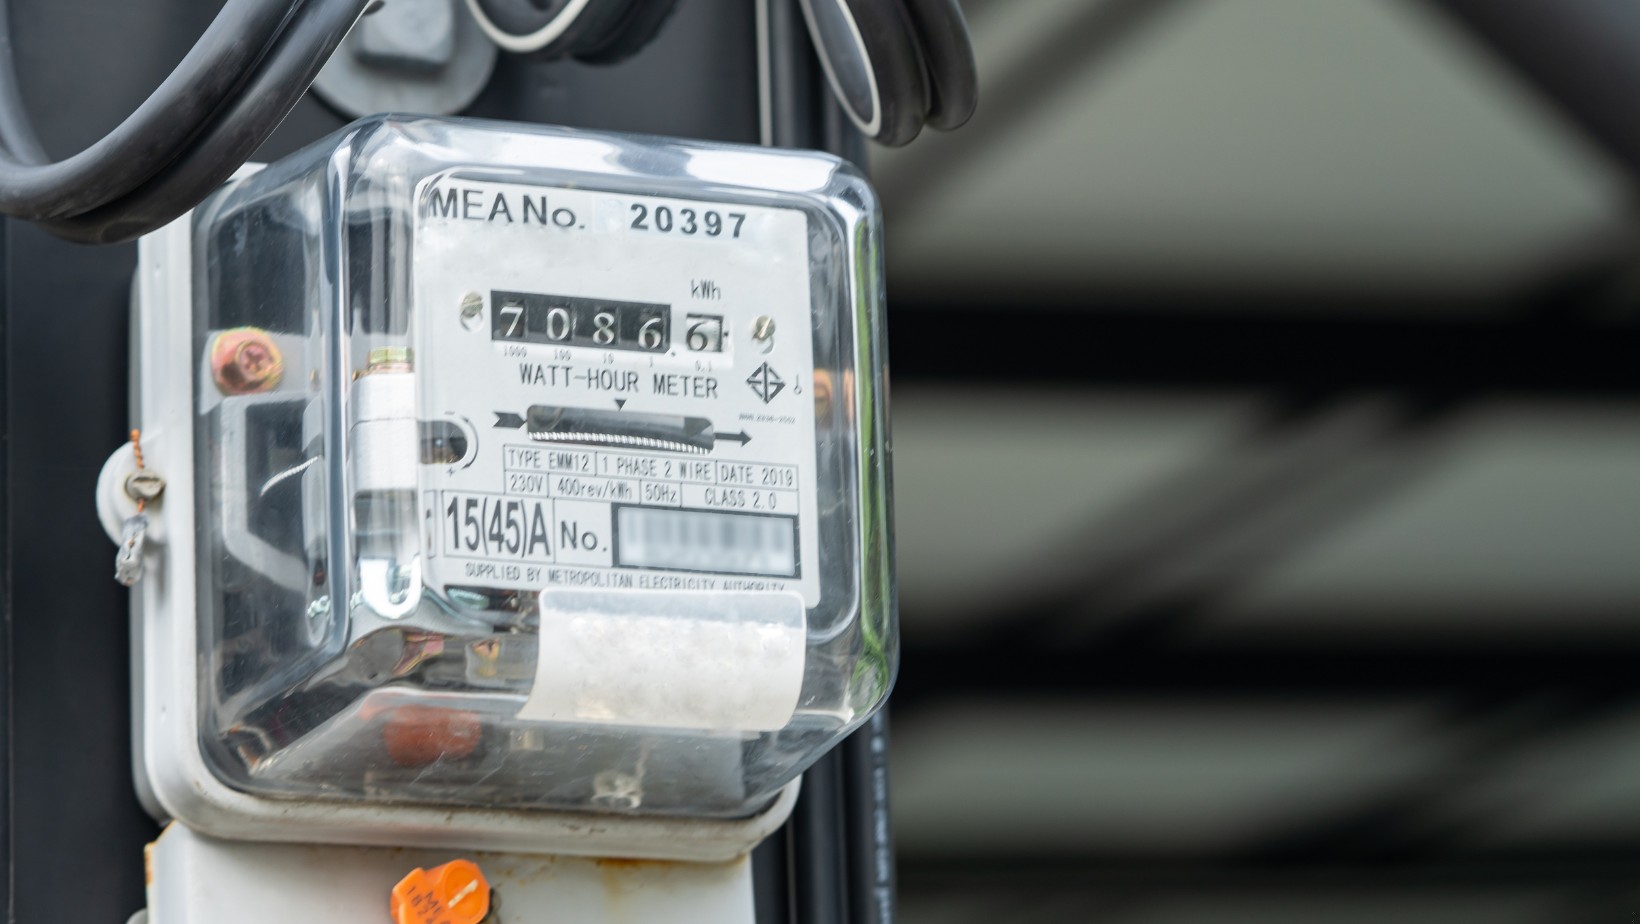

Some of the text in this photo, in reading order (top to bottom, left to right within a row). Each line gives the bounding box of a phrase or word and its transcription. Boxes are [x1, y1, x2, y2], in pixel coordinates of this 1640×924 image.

[429, 187, 747, 239] MEA No. 20397
[690, 279, 722, 300] kWh
[503, 346, 528, 359] 1000
[553, 348, 572, 362] 100
[603, 352, 615, 365] 10
[519, 363, 719, 399] WATT-HOUR METER
[508, 449, 590, 472] TYPE EMM12
[602, 456, 712, 481] 1 PHASE 2 WIRE
[510, 474, 543, 493] 230V
[720, 464, 793, 487] DATE 2019
[557, 476, 633, 500] 400rev/kWh
[645, 483, 677, 504] 50Hz
[704, 487, 777, 510] CLASS 2.0
[447, 496, 551, 558] 15(45)A
[560, 520, 607, 552] No.
[465, 562, 520, 581] SUPPLIED
[527, 568, 541, 582] BY
[548, 568, 633, 588] METROPOLITAN
[639, 574, 714, 590] ELECTRICITY
